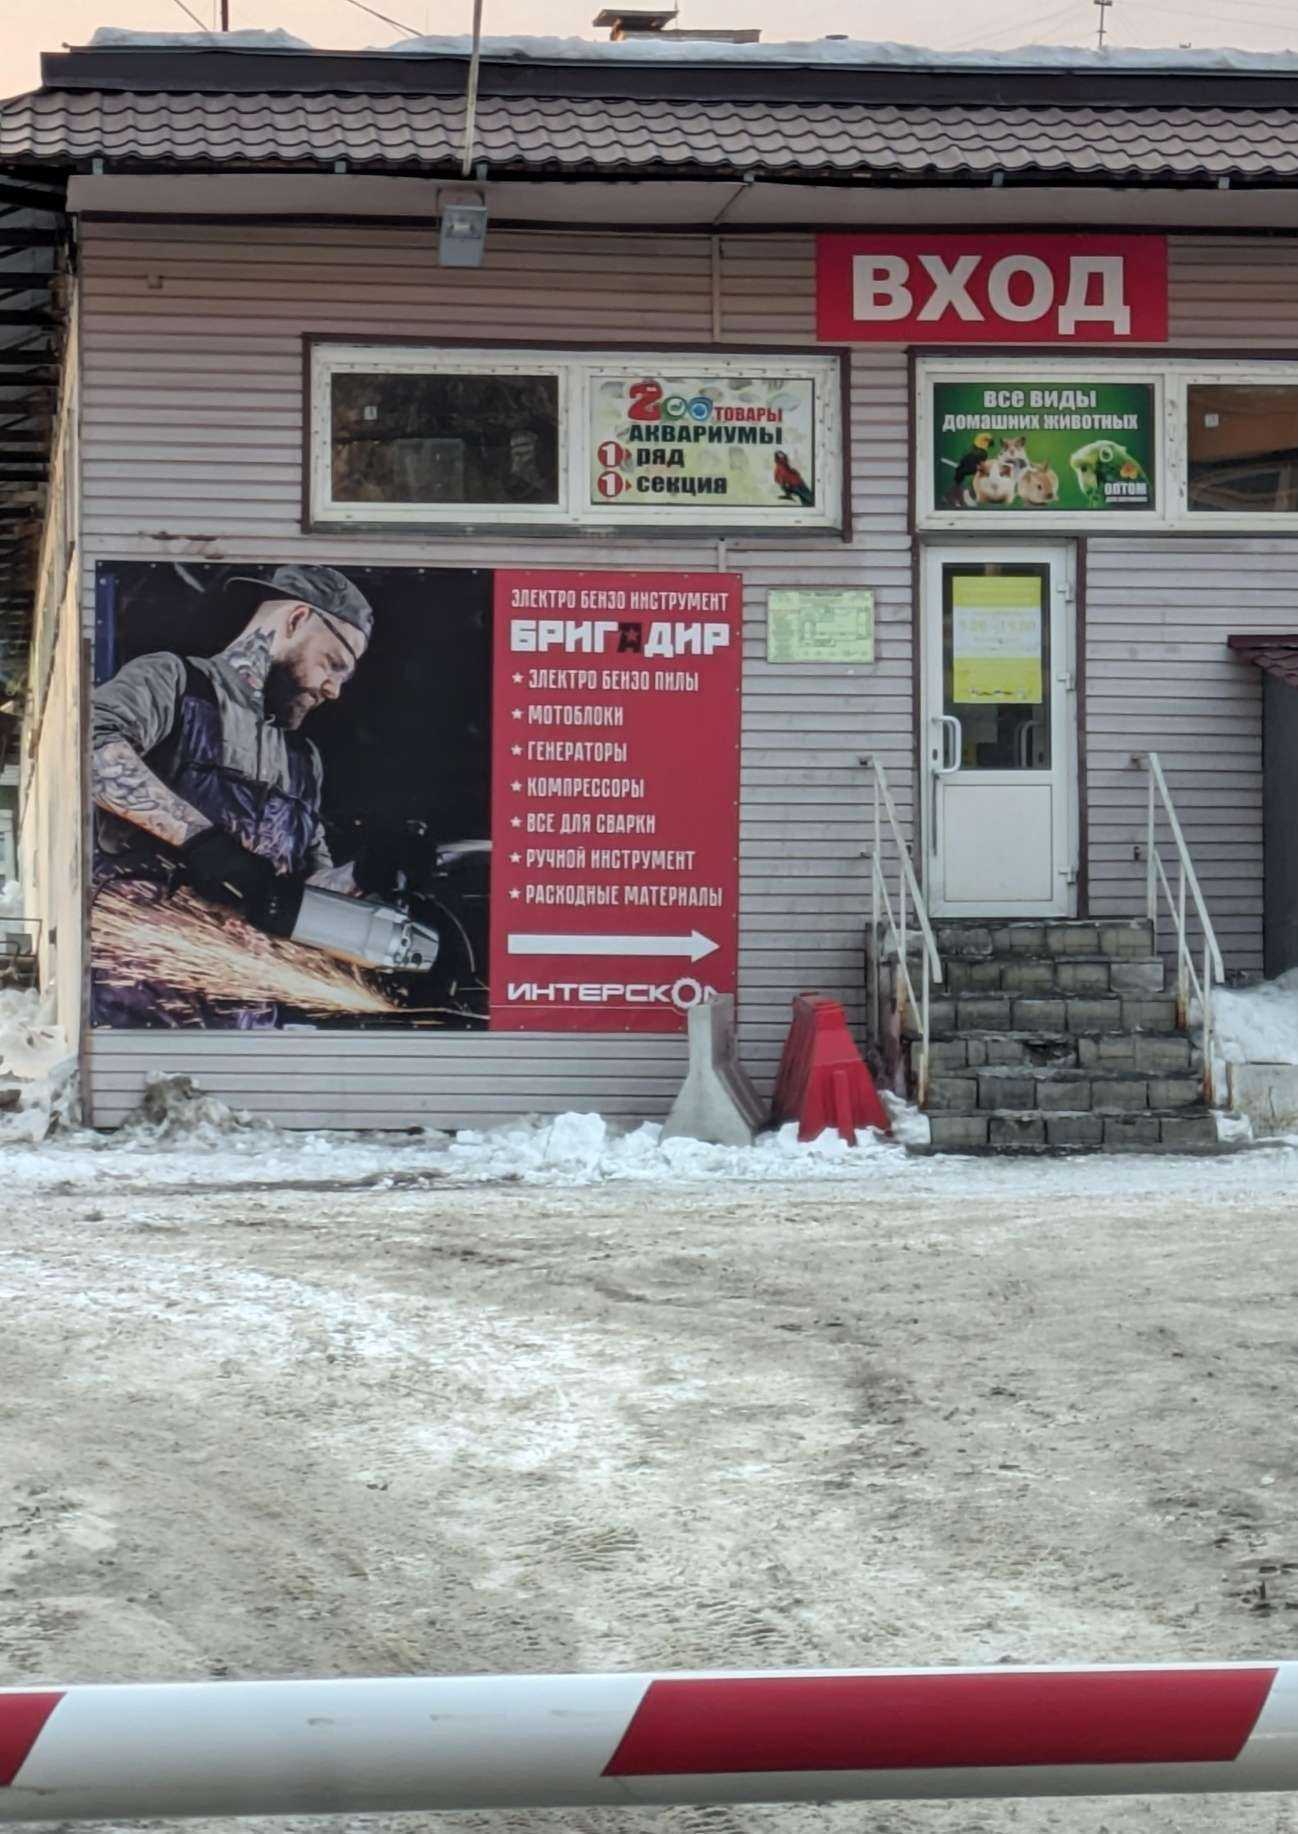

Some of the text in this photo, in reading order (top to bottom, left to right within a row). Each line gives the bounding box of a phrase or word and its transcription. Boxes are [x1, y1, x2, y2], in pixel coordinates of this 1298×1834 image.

[853, 254, 1131, 335] ВХОД
[629, 424, 783, 445] АКВАРИУМЫ
[511, 589, 729, 611] ЭЛЕКТРО БЕНЗО ИНСТРУМЕНТ
[510, 619, 731, 658] БРИГАДИР
[528, 669, 699, 692] ЭЛЕКТРО БЕНЗО ПИЛЫ
[527, 705, 624, 726] МОТОБЛОКИ
[527, 741, 628, 762] ГЕНЕРАТОРЫ
[527, 777, 645, 798] КОМПРЕССОРЫ
[526, 813, 656, 834] ВСЕ ДЛЯ СВАРКИ
[525, 846, 696, 870] РУЧНОЙ ИНСТРУМЕНТ
[525, 884, 723, 907] РАСХОДНЫЕ МАТЕРИАЛЫ
